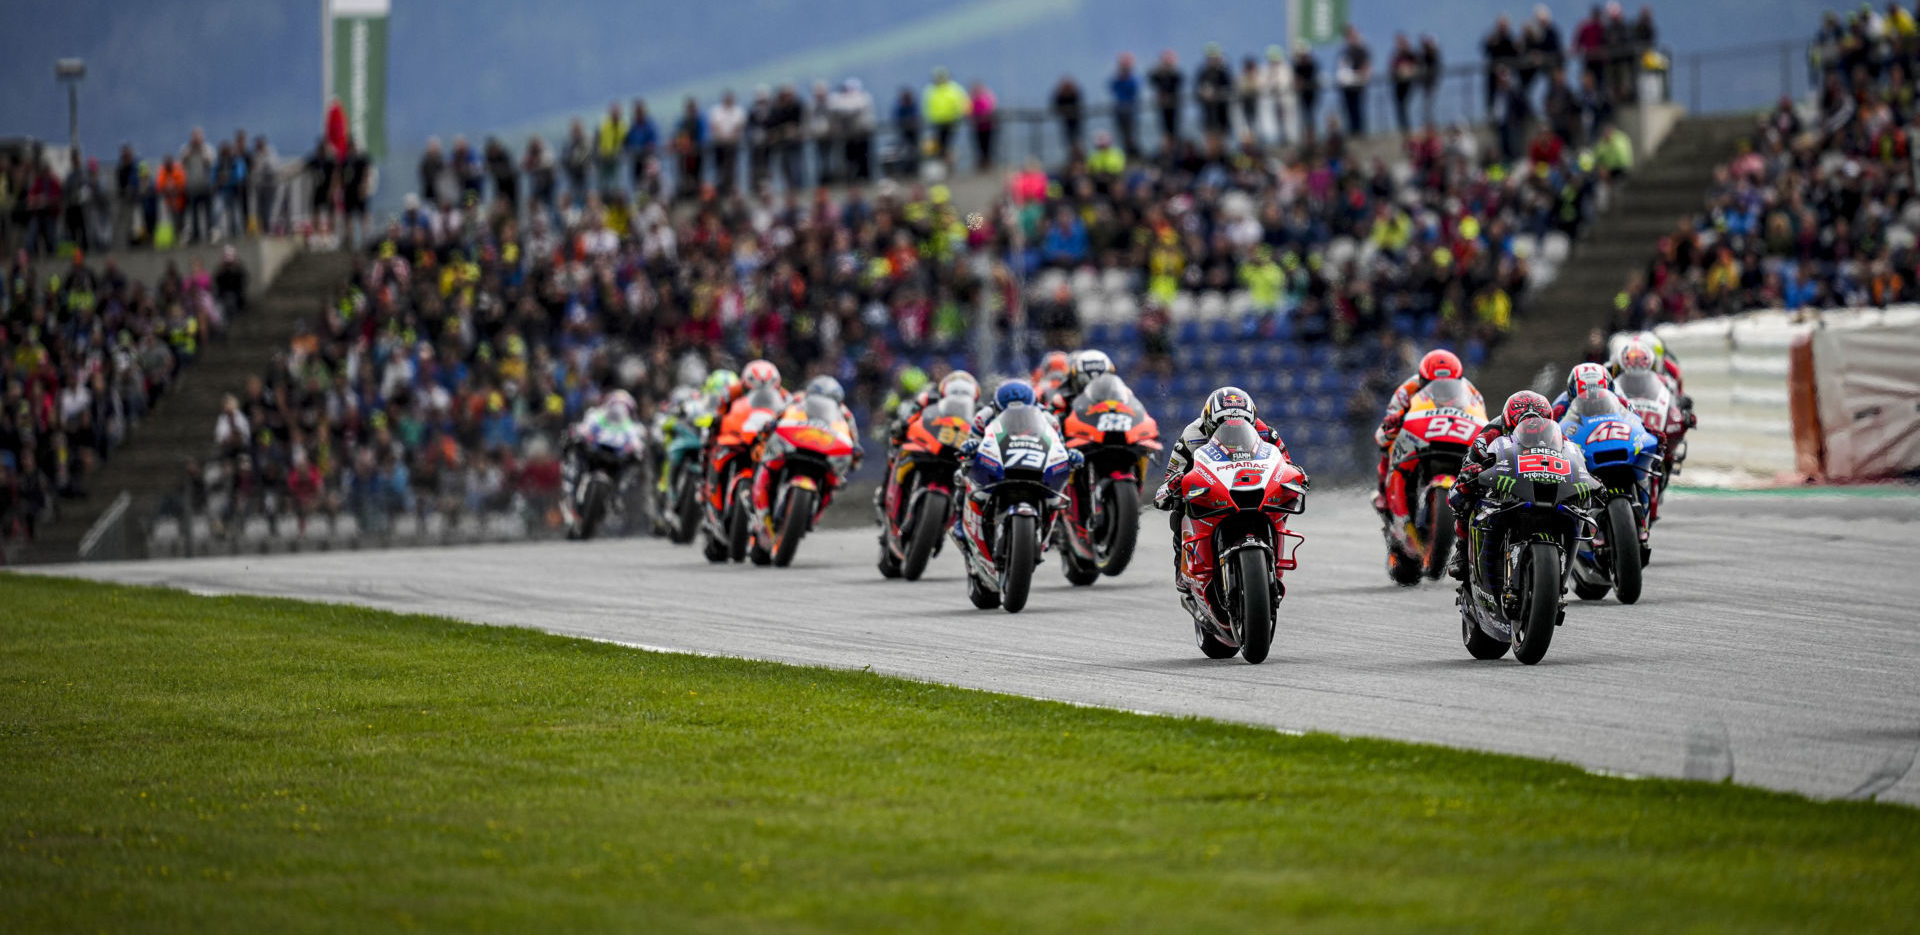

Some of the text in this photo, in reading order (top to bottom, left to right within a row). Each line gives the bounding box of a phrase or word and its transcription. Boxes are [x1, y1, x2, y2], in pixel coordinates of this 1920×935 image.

[1424, 417, 1477, 441] 93
[1585, 421, 1632, 446] 42
[1003, 448, 1046, 468] 73
[1216, 461, 1269, 472] PRAMAC
[1517, 454, 1571, 475] 20
[1232, 468, 1265, 488] 5
[1523, 471, 1567, 483] MONSTER
